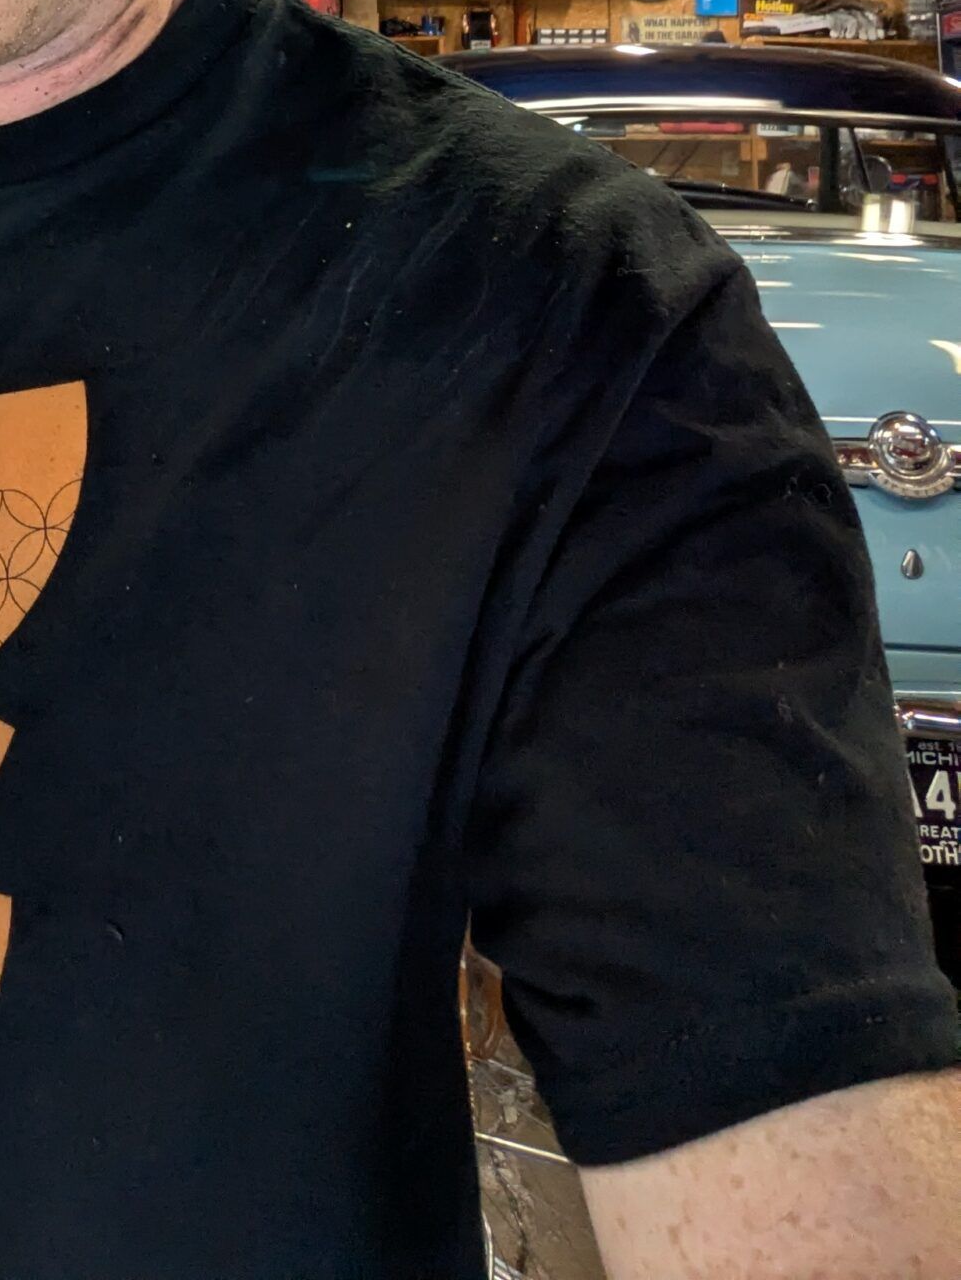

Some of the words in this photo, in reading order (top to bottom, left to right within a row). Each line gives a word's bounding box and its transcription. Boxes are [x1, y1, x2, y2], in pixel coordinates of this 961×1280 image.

[755, 0, 794, 15] Holley
[644, 19, 668, 27] WHAT
[657, 31, 674, 40] THE
[904, 751, 961, 766] MICHI
[919, 825, 960, 839] REAT
